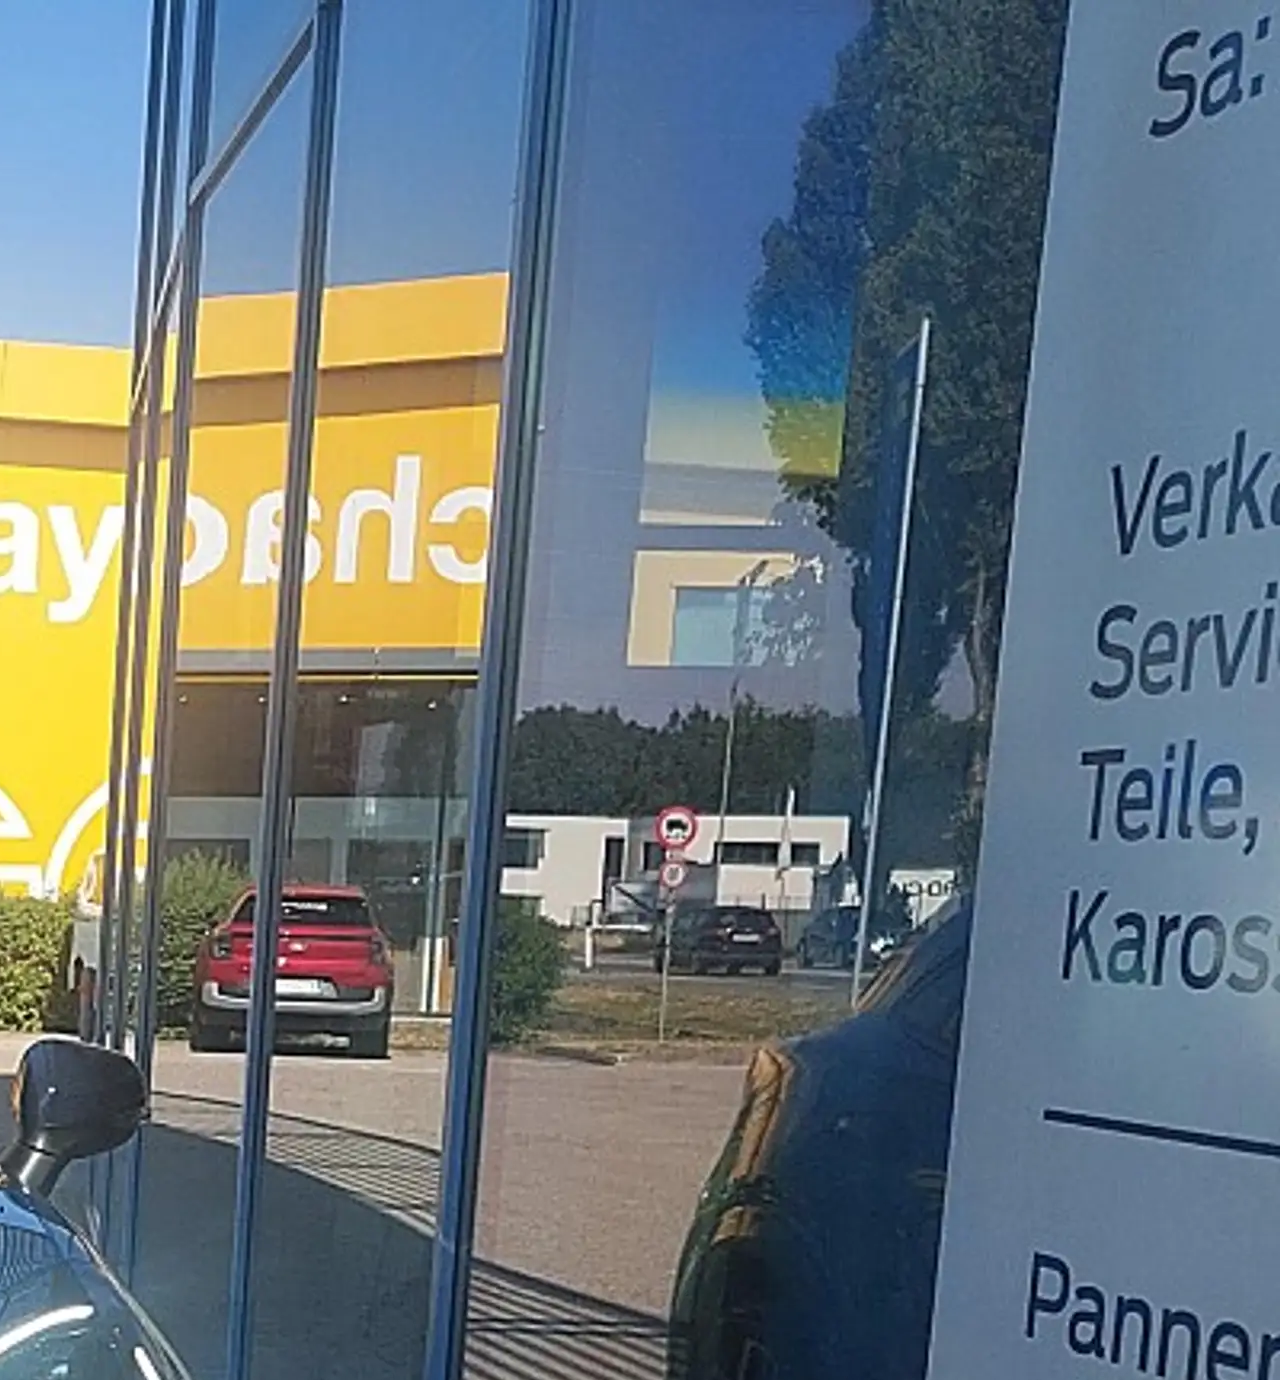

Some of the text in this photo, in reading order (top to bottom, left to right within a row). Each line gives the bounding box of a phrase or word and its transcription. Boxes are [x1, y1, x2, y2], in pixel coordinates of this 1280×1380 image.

[1148, 15, 1272, 138] Sa:
[1111, 429, 1280, 556] Verk
[1089, 582, 1280, 699] Servi
[1080, 738, 1259, 856] Teile,
[1061, 889, 1280, 993] Karos
